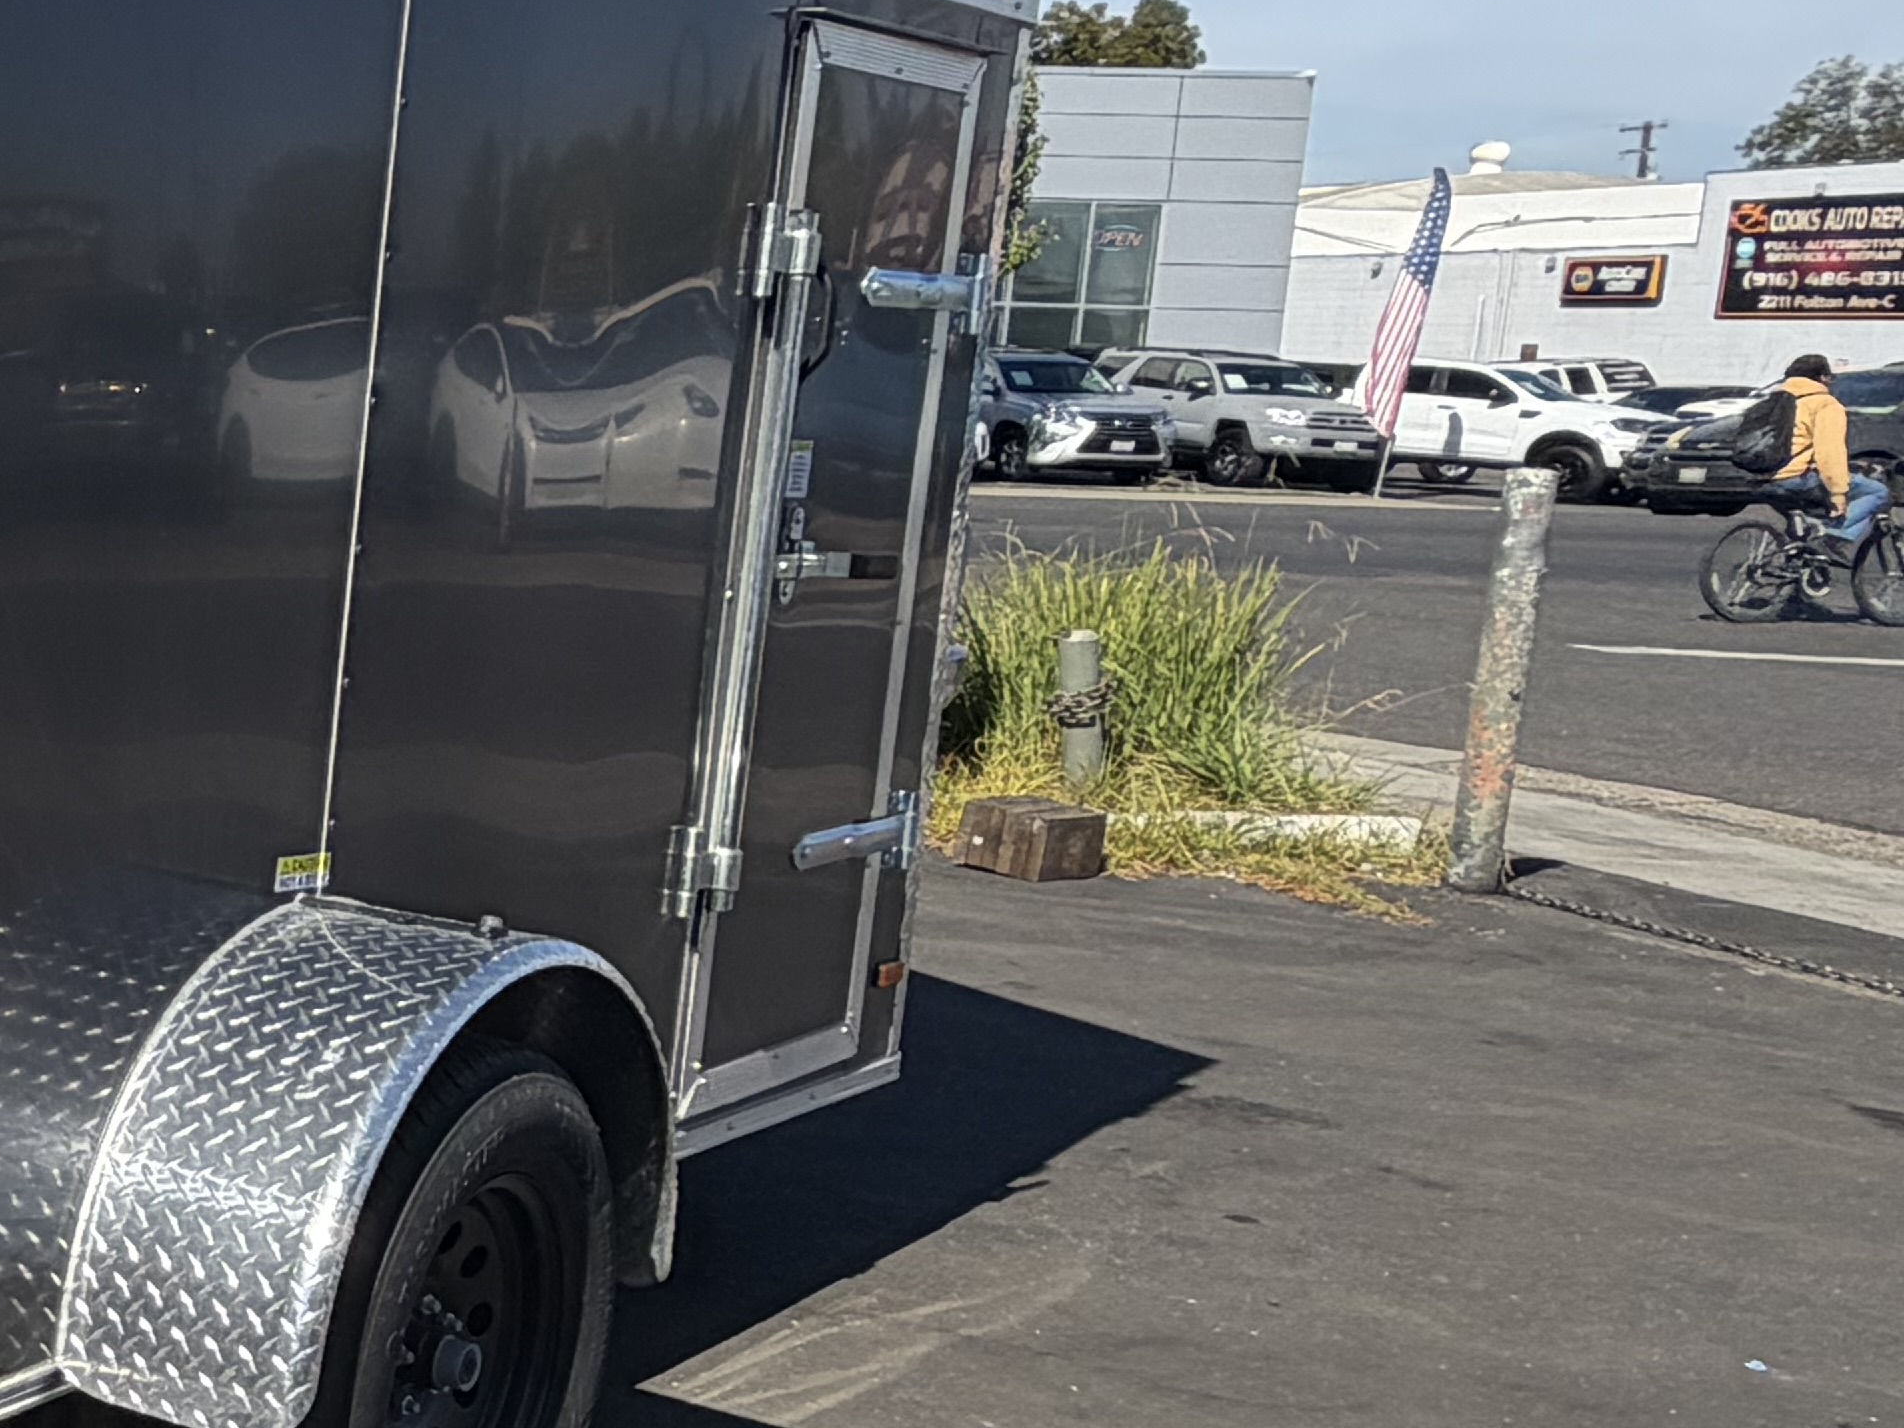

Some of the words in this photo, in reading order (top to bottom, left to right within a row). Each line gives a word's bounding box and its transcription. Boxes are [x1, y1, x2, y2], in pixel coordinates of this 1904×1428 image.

[1770, 209, 1823, 233] COOKS
[1823, 206, 1868, 231] AUTO
[1094, 230, 1143, 246] OPEN
[1742, 269, 1799, 290] (916)
[1757, 295, 1792, 309] 2211
[1793, 294, 1845, 309] Fulton
